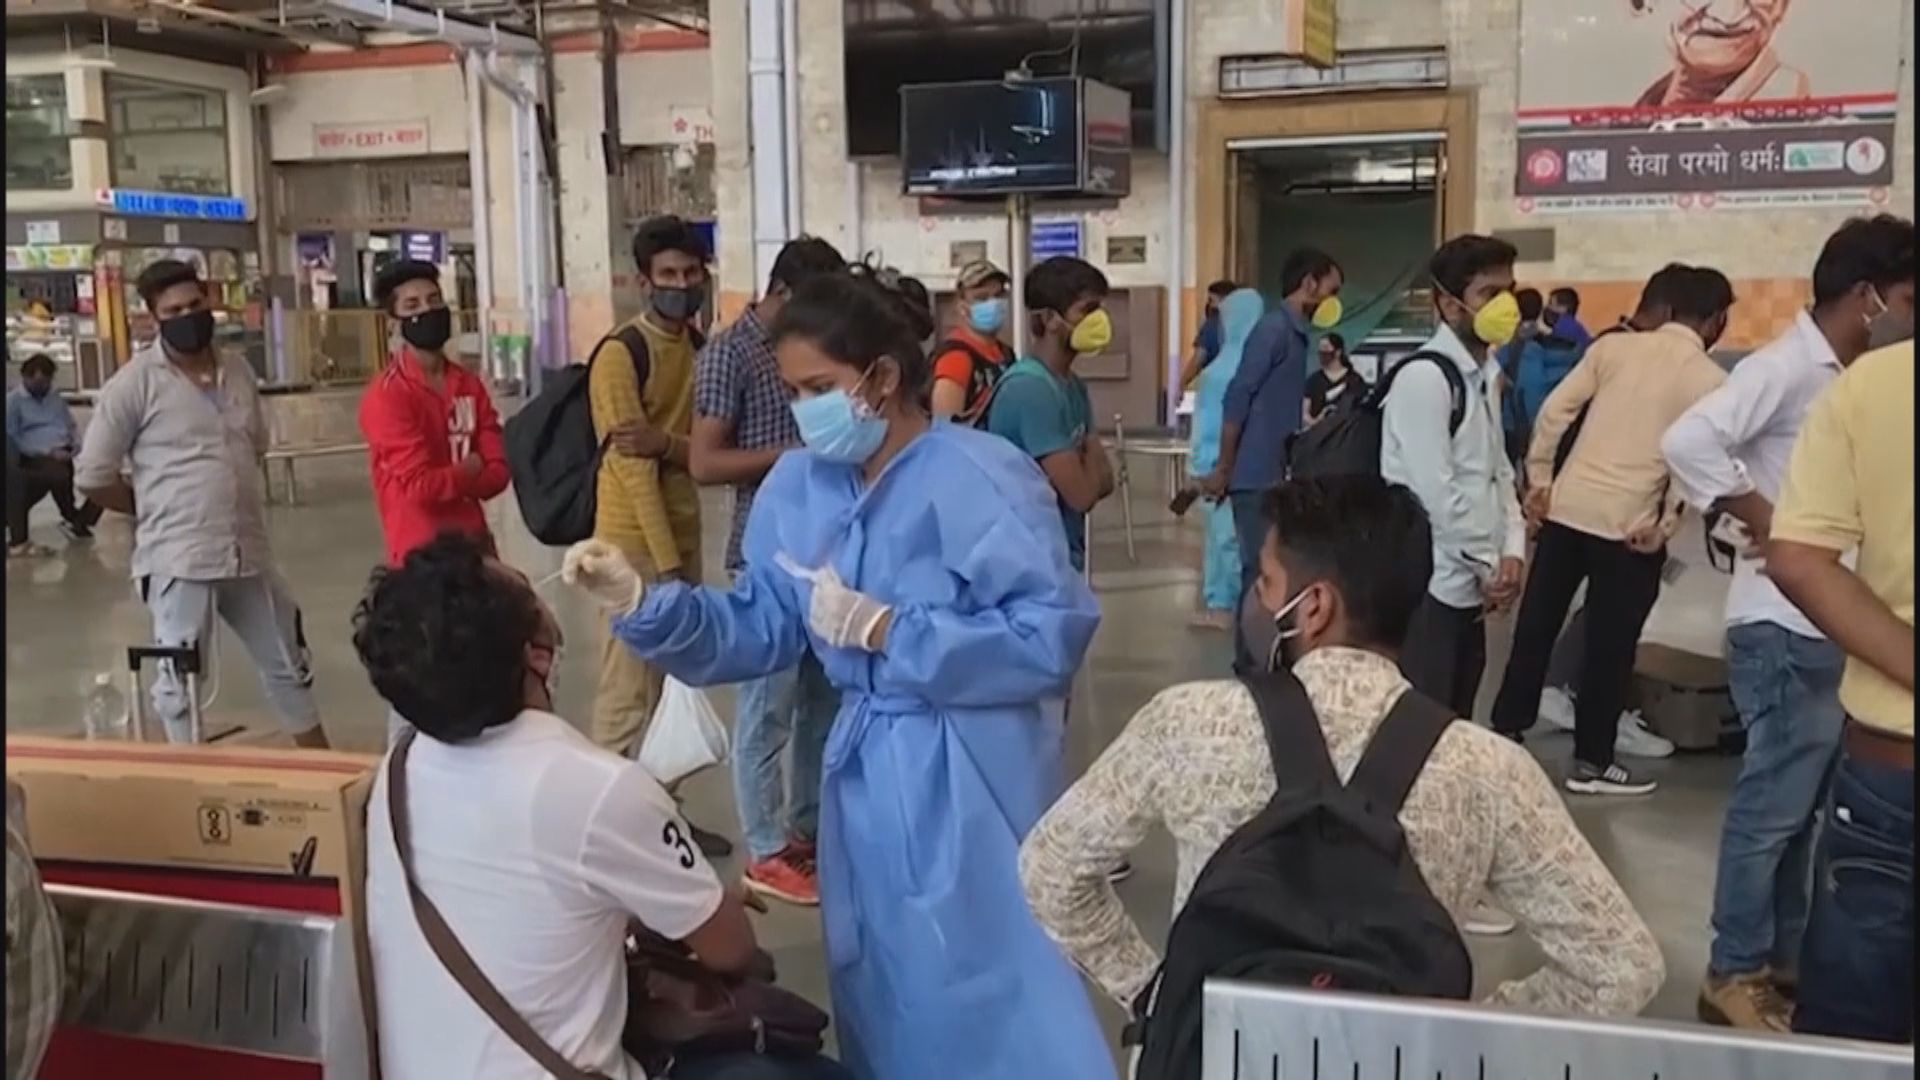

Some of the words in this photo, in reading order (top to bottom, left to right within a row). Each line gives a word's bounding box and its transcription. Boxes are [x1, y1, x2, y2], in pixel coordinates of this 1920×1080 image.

[355, 131, 384, 148] EXIT
[1627, 146, 1670, 176] सेवा
[1678, 143, 1729, 176] परमो
[663, 820, 695, 870] 3
